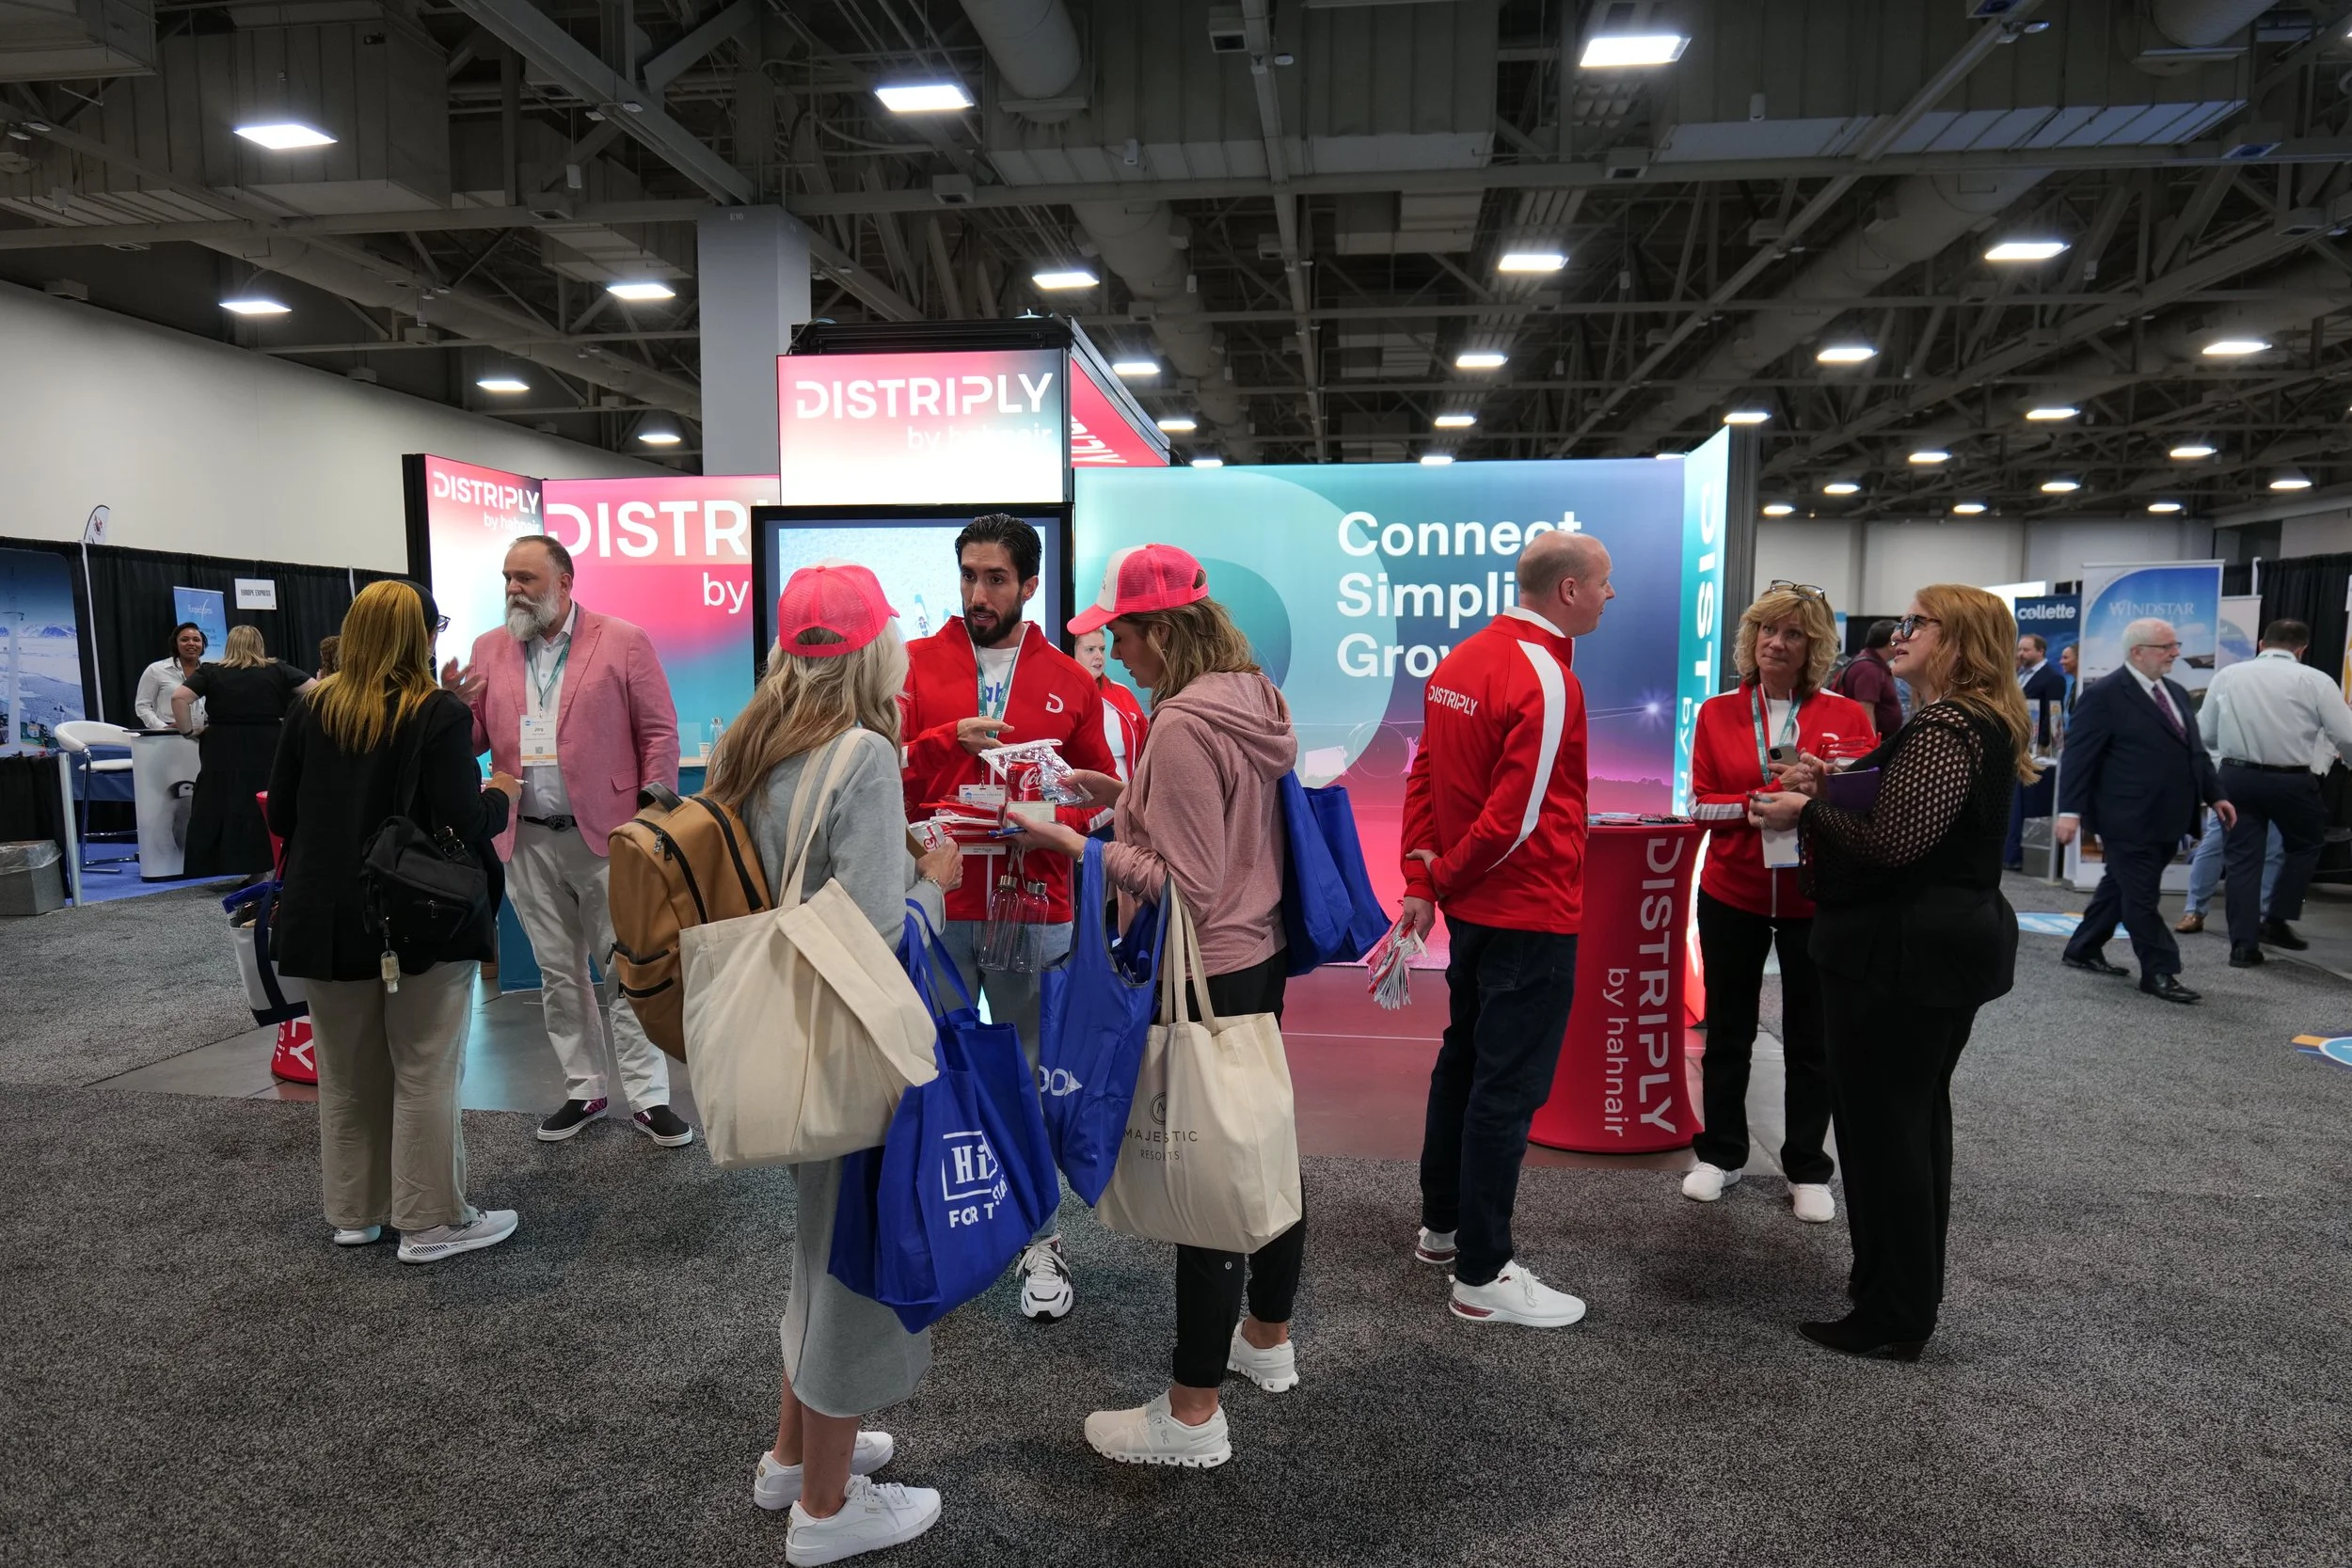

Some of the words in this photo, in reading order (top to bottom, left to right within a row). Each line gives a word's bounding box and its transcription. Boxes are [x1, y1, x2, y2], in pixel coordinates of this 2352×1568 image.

[796, 372, 1053, 420] DISTRIPLY
[433, 470, 540, 515] DISTRIPLY
[484, 511, 500, 531] by
[547, 499, 768, 558] DISTR
[703, 572, 749, 613] by
[1337, 571, 1516, 628] Simpli
[2017, 604, 2076, 620] collette
[2109, 601, 2194, 617] WINDSTAR
[1337, 633, 1454, 678] Gro
[1428, 685, 1478, 717] DISTRIPLY
[1603, 968, 1630, 1007] by
[1638, 836, 1685, 1134] DISTRIPLY
[1604, 1018, 1629, 1137] hahnair
[1123, 1129, 1198, 1143] MAJESTIC
[948, 1206, 979, 1228] FOR
